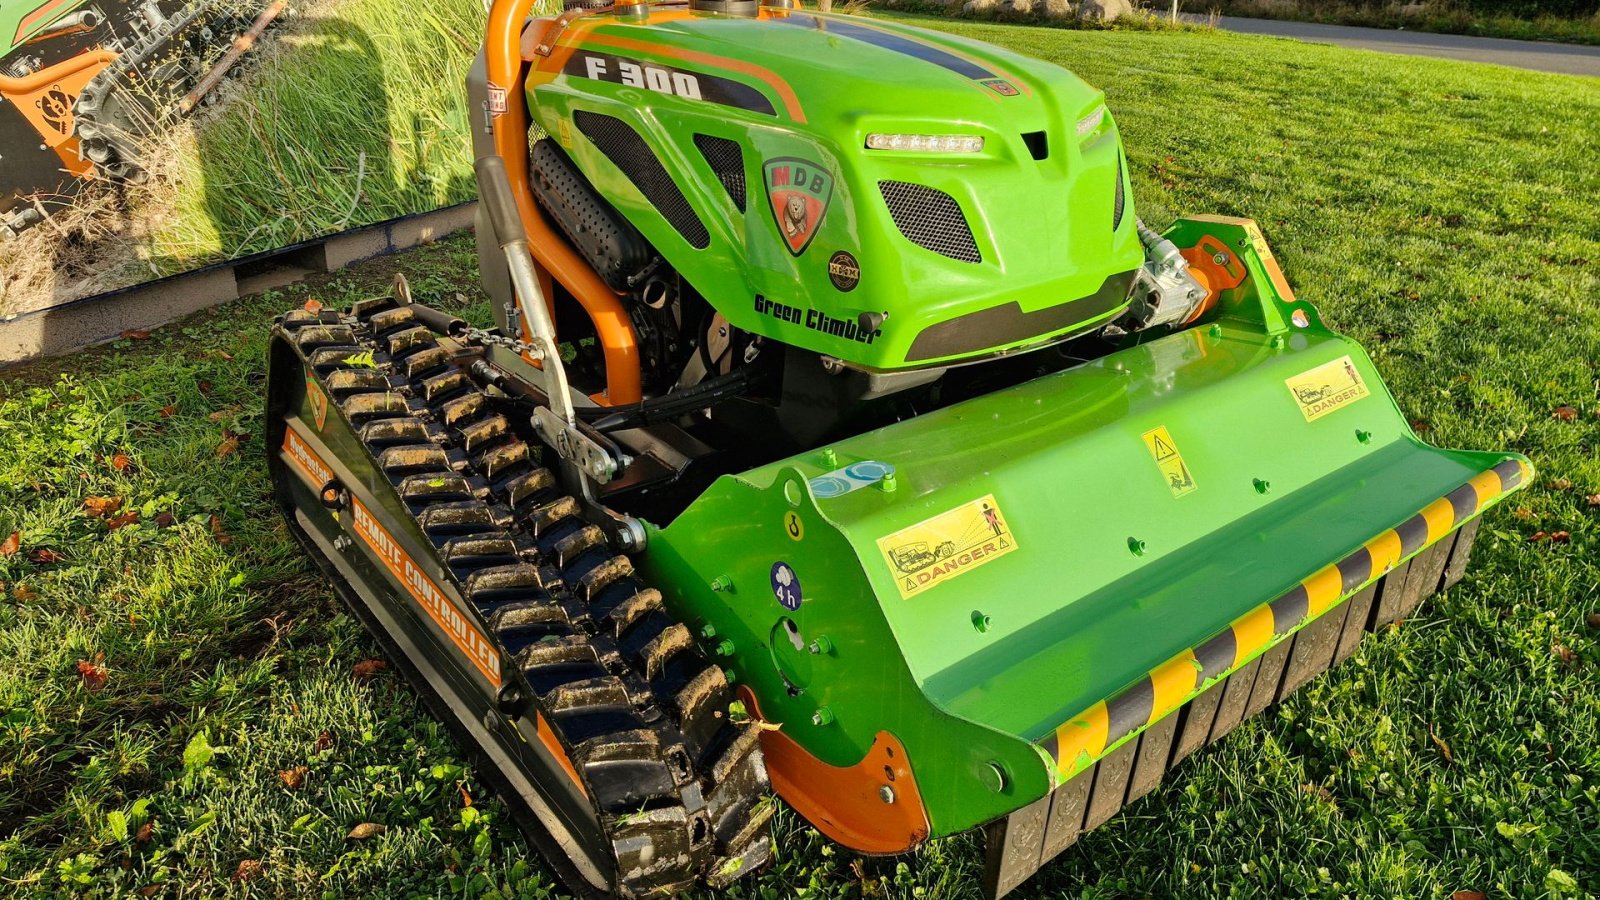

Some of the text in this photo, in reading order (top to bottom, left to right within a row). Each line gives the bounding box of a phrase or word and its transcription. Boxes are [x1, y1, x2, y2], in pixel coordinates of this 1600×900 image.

[585, 56, 703, 101] F 300
[771, 165, 825, 194] MDB
[754, 293, 883, 345] Green Climber
[1314, 389, 1358, 413] DANGER
[916, 542, 997, 586] DANGER
[354, 502, 500, 681] REMOTE CONTROLLED
[776, 586, 796, 608] 4 h
